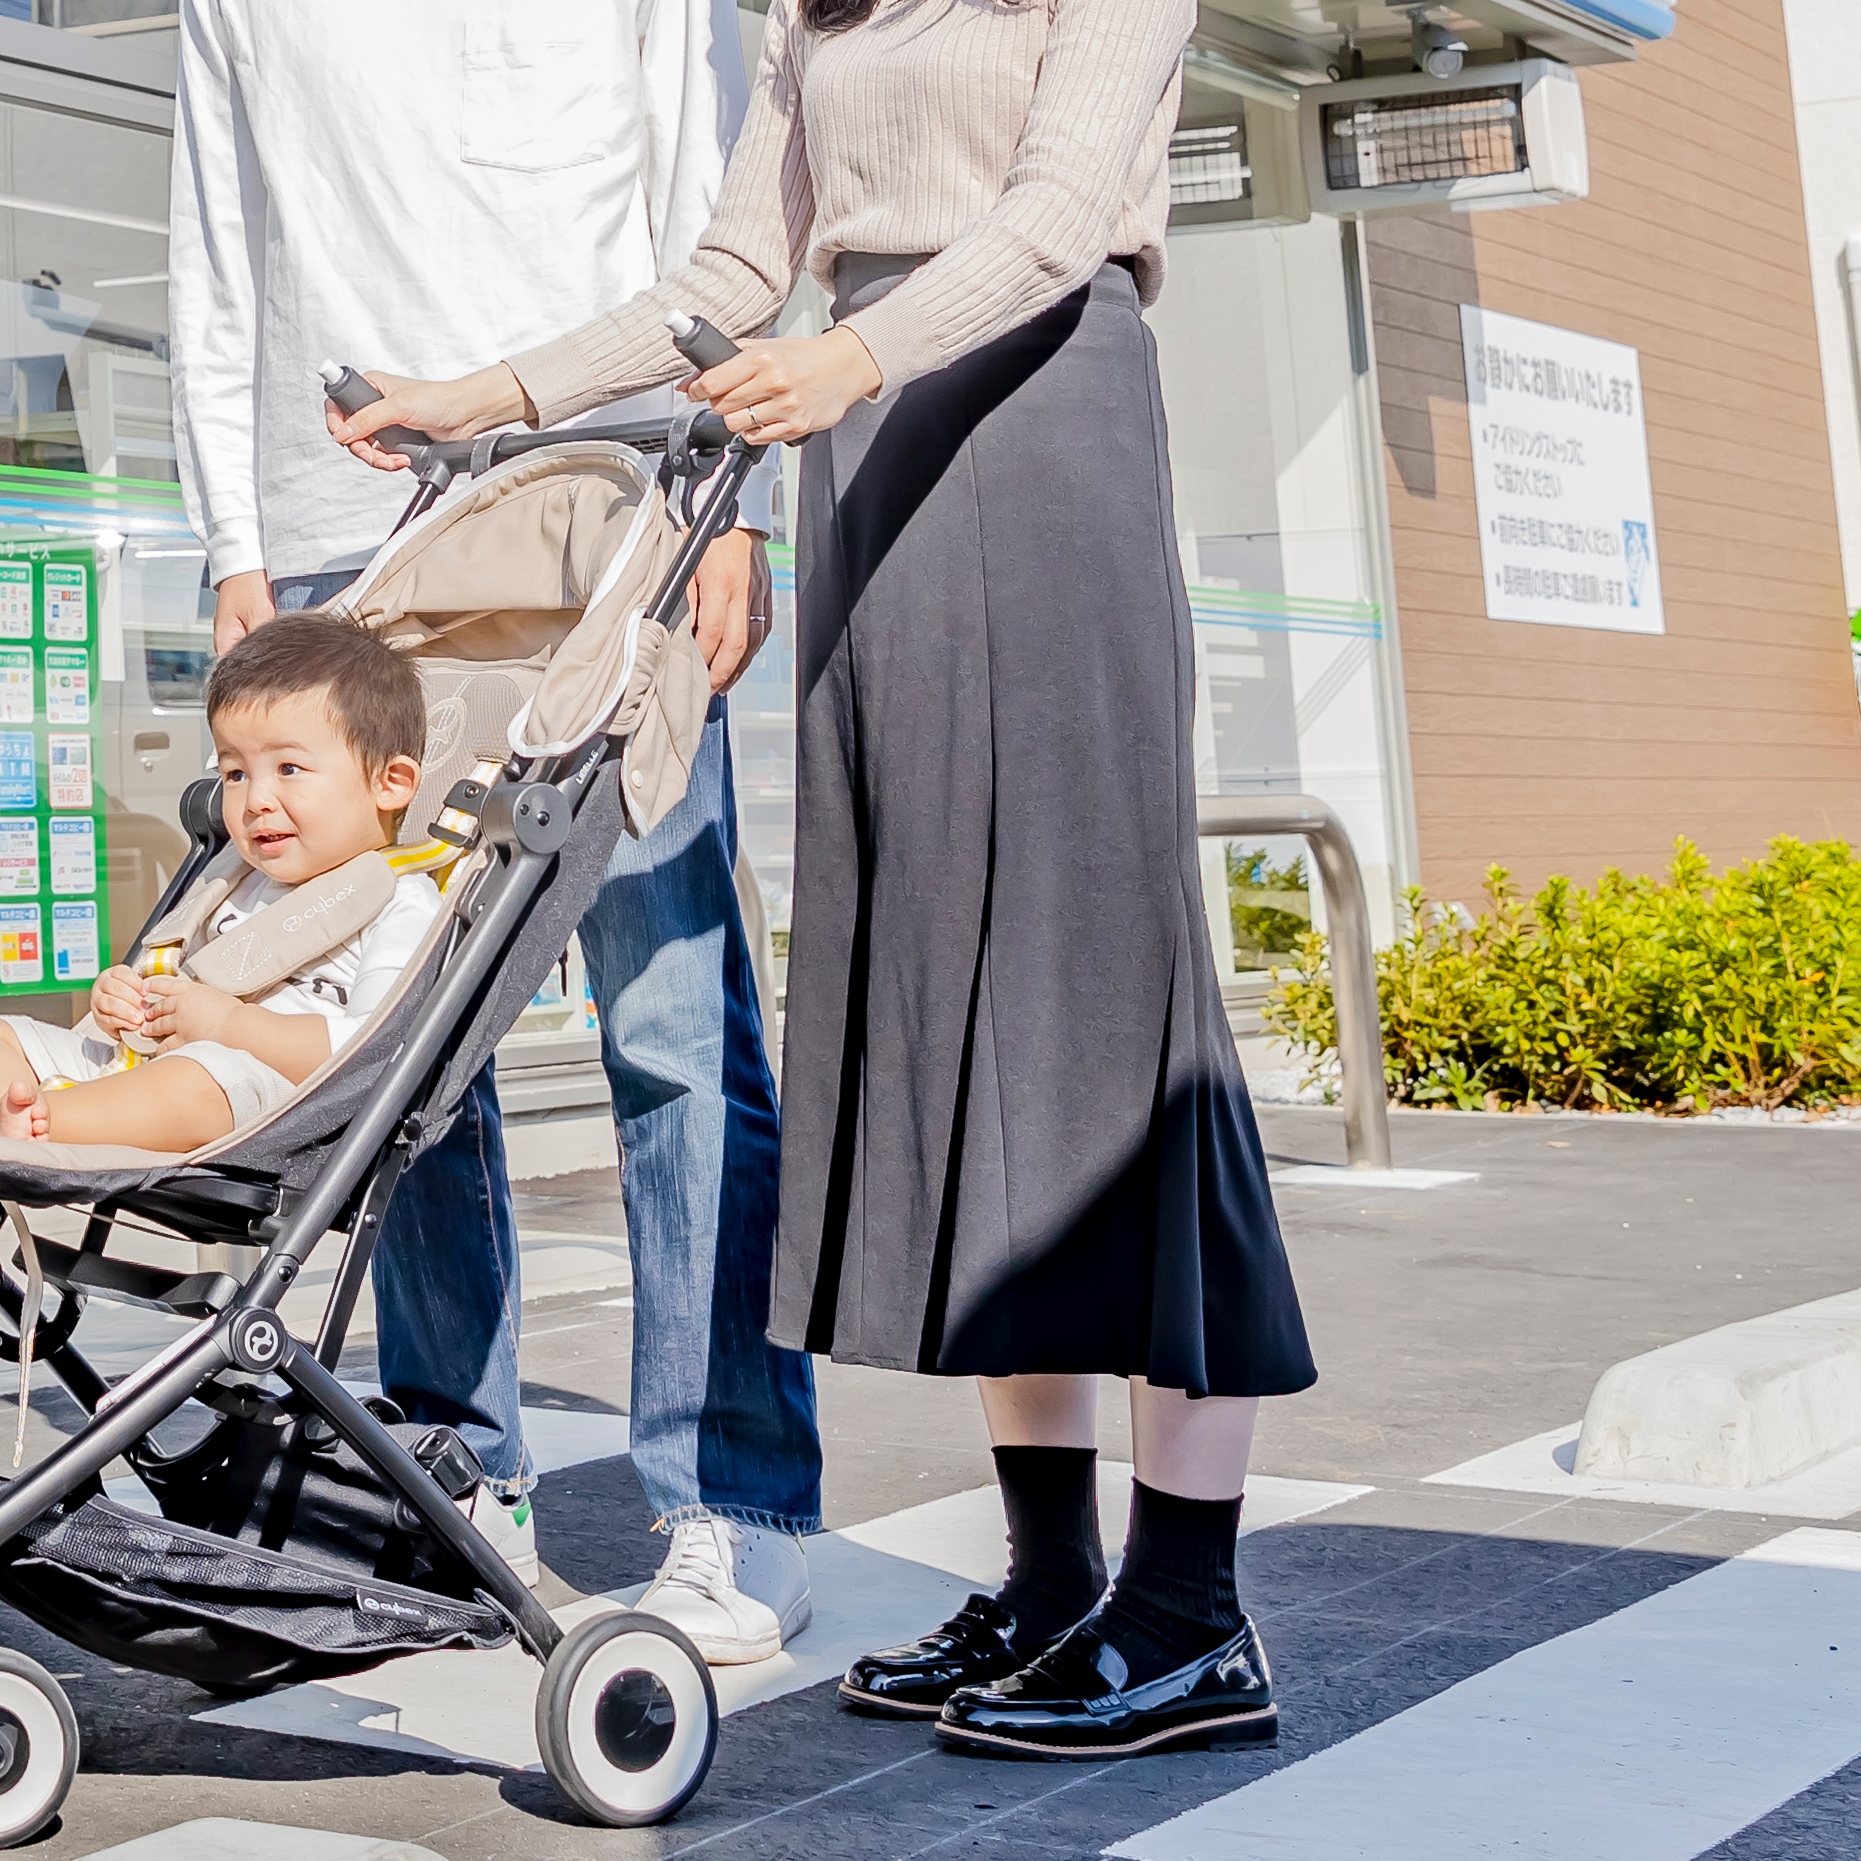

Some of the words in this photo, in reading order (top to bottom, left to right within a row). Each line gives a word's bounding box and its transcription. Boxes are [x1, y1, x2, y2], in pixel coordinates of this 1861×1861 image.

[1473, 344, 1634, 417] お静かにお願いいたします
[380, 1601, 422, 1617] cybex
